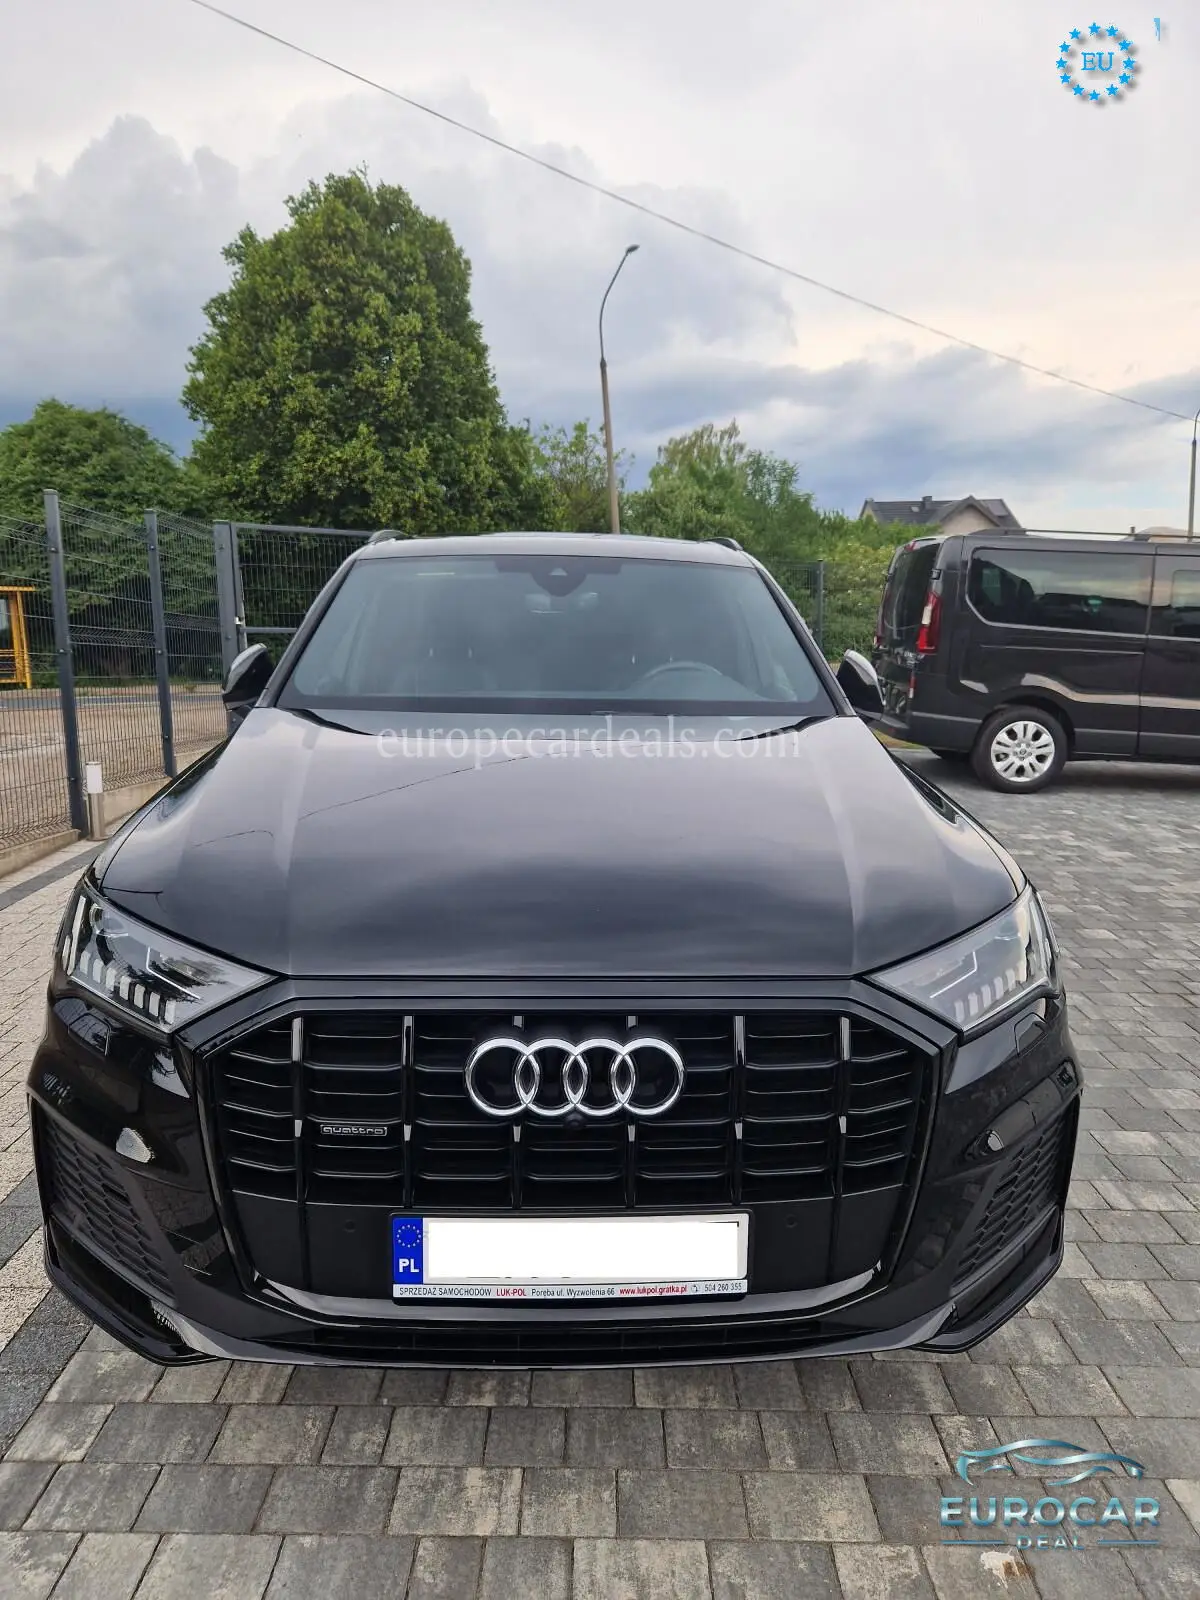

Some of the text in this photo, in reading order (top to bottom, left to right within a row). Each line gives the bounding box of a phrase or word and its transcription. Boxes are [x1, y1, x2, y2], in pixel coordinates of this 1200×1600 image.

[323, 1126, 384, 1134] quattro
[399, 1258, 419, 1272] PL
[496, 1288, 526, 1297] LUK-POL
[556, 1288, 565, 1296] ul.
[566, 1288, 605, 1298] Wyzwolenia
[606, 1287, 615, 1296] 66
[619, 1284, 687, 1296] www.lukpol.gratka.pl
[704, 1283, 716, 1292] 504
[717, 1283, 729, 1292] 260
[730, 1282, 743, 1291] 355
